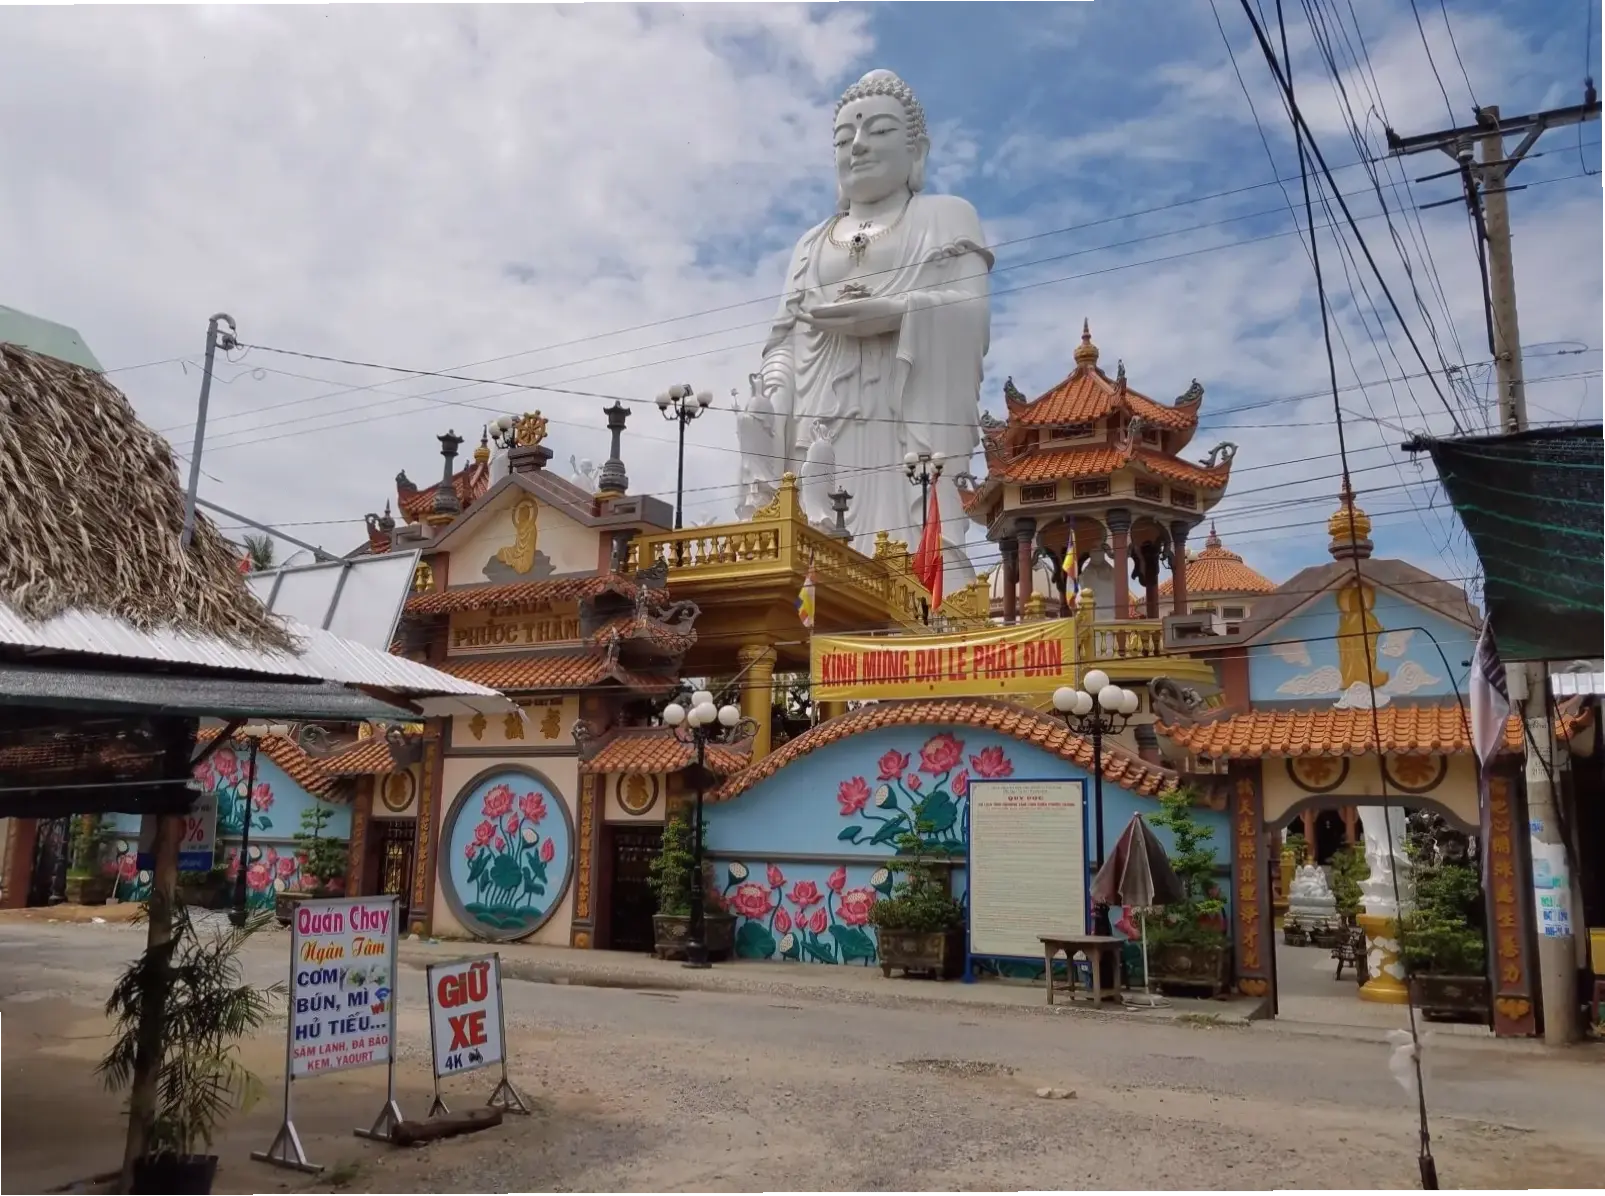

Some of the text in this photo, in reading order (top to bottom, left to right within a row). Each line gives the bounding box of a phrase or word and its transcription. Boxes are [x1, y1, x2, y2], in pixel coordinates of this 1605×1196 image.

[822, 646, 857, 687] KÍNH
[862, 644, 910, 686] MỪNG
[915, 648, 942, 690] ĐẠI
[948, 636, 967, 681] LỄ
[973, 638, 1018, 687] PHẬT
[298, 905, 390, 935] Quán Chay
[300, 936, 385, 965] Ngân Tâm
[297, 968, 338, 987] CƠM
[437, 961, 491, 1009] GIỮ
[296, 987, 369, 1013] BÚN, MÌ
[295, 1016, 321, 1040] HỦ
[448, 1009, 488, 1052] XE
[445, 1053, 463, 1070] 4K
